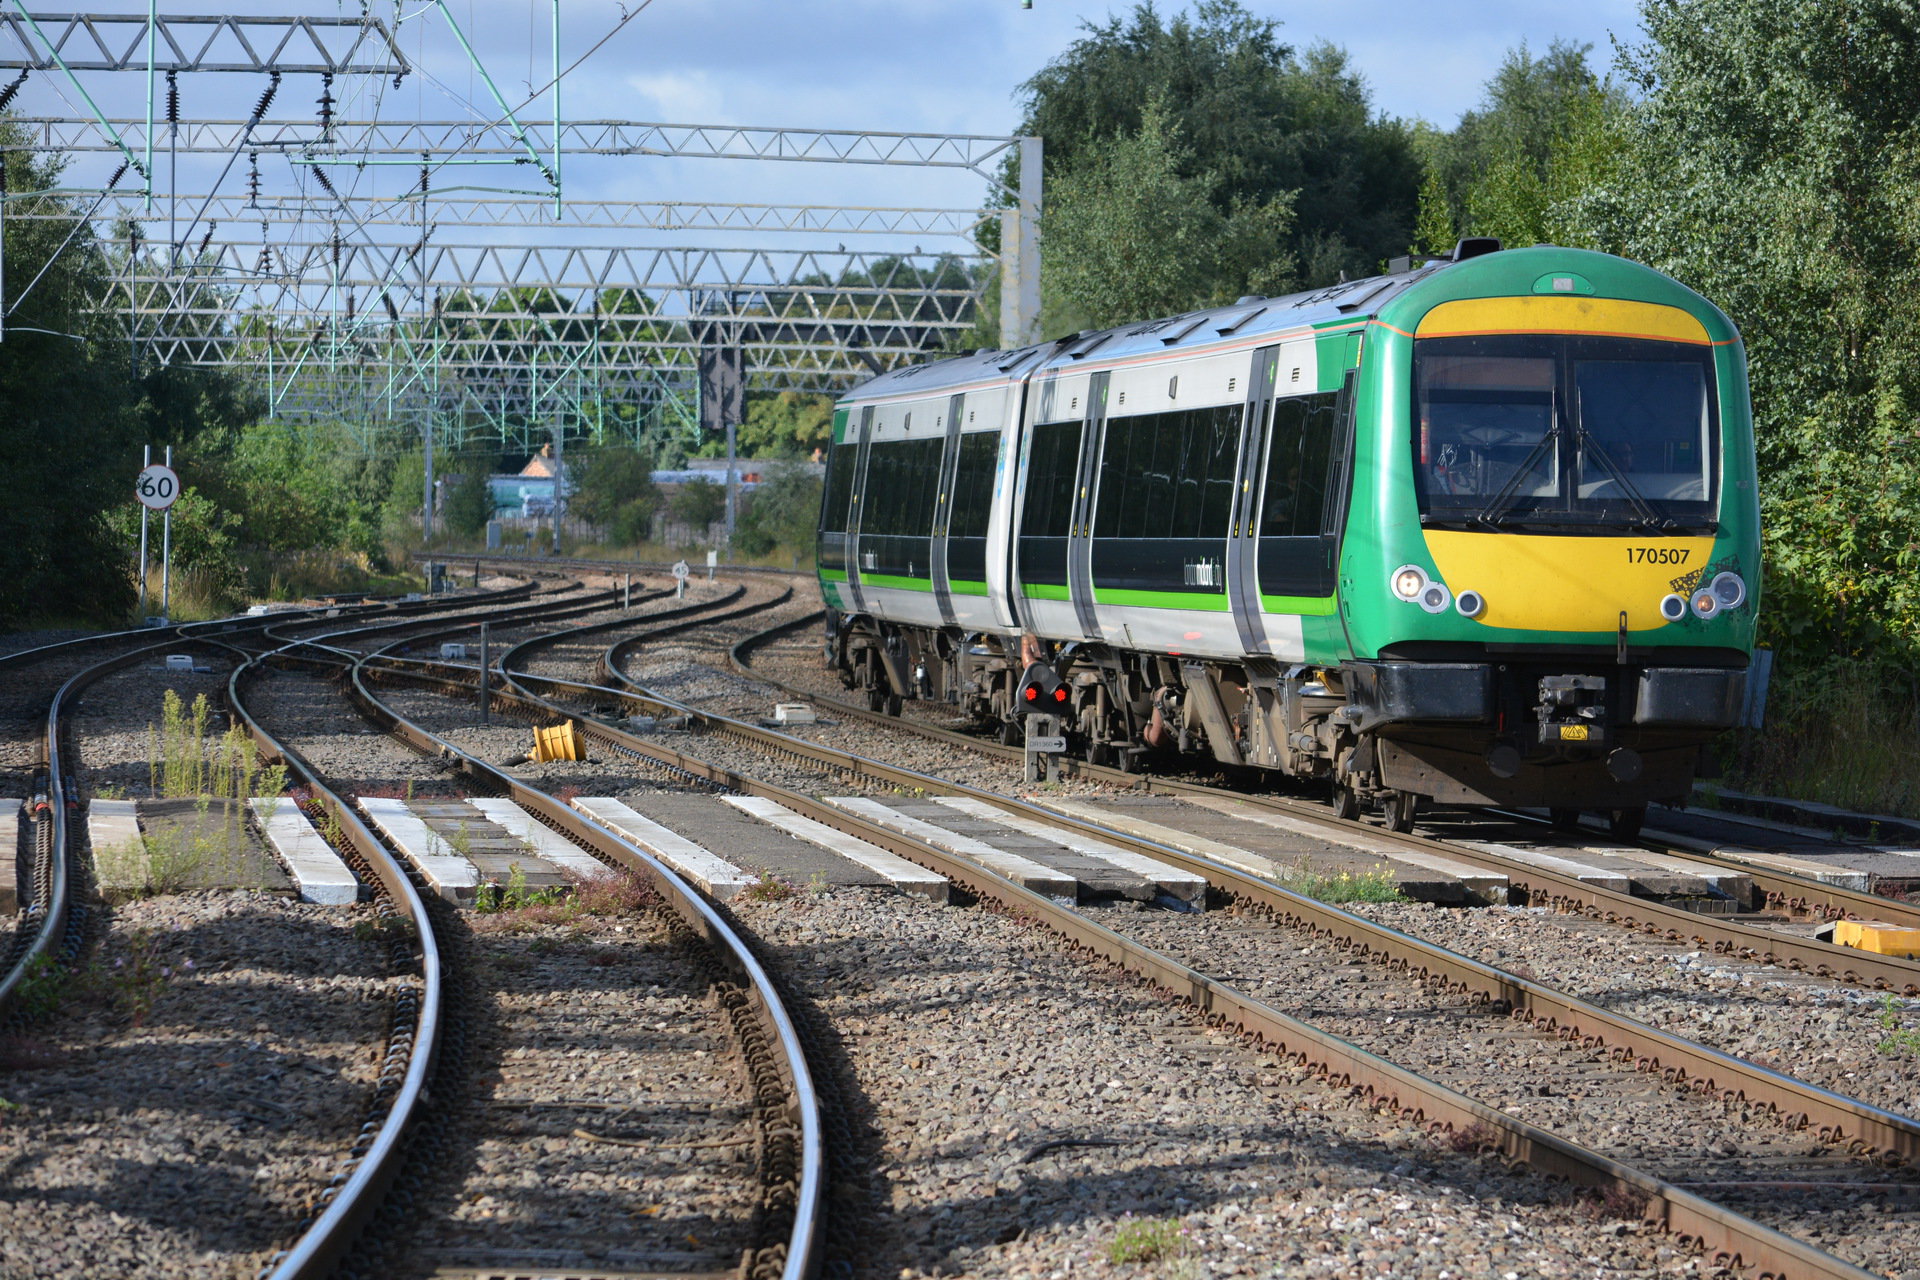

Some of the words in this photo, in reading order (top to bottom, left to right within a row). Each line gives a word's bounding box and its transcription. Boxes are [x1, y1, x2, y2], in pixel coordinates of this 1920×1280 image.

[142, 477, 172, 498] 60
[1627, 548, 1690, 565] 170507
[675, 566, 687, 576] 45
